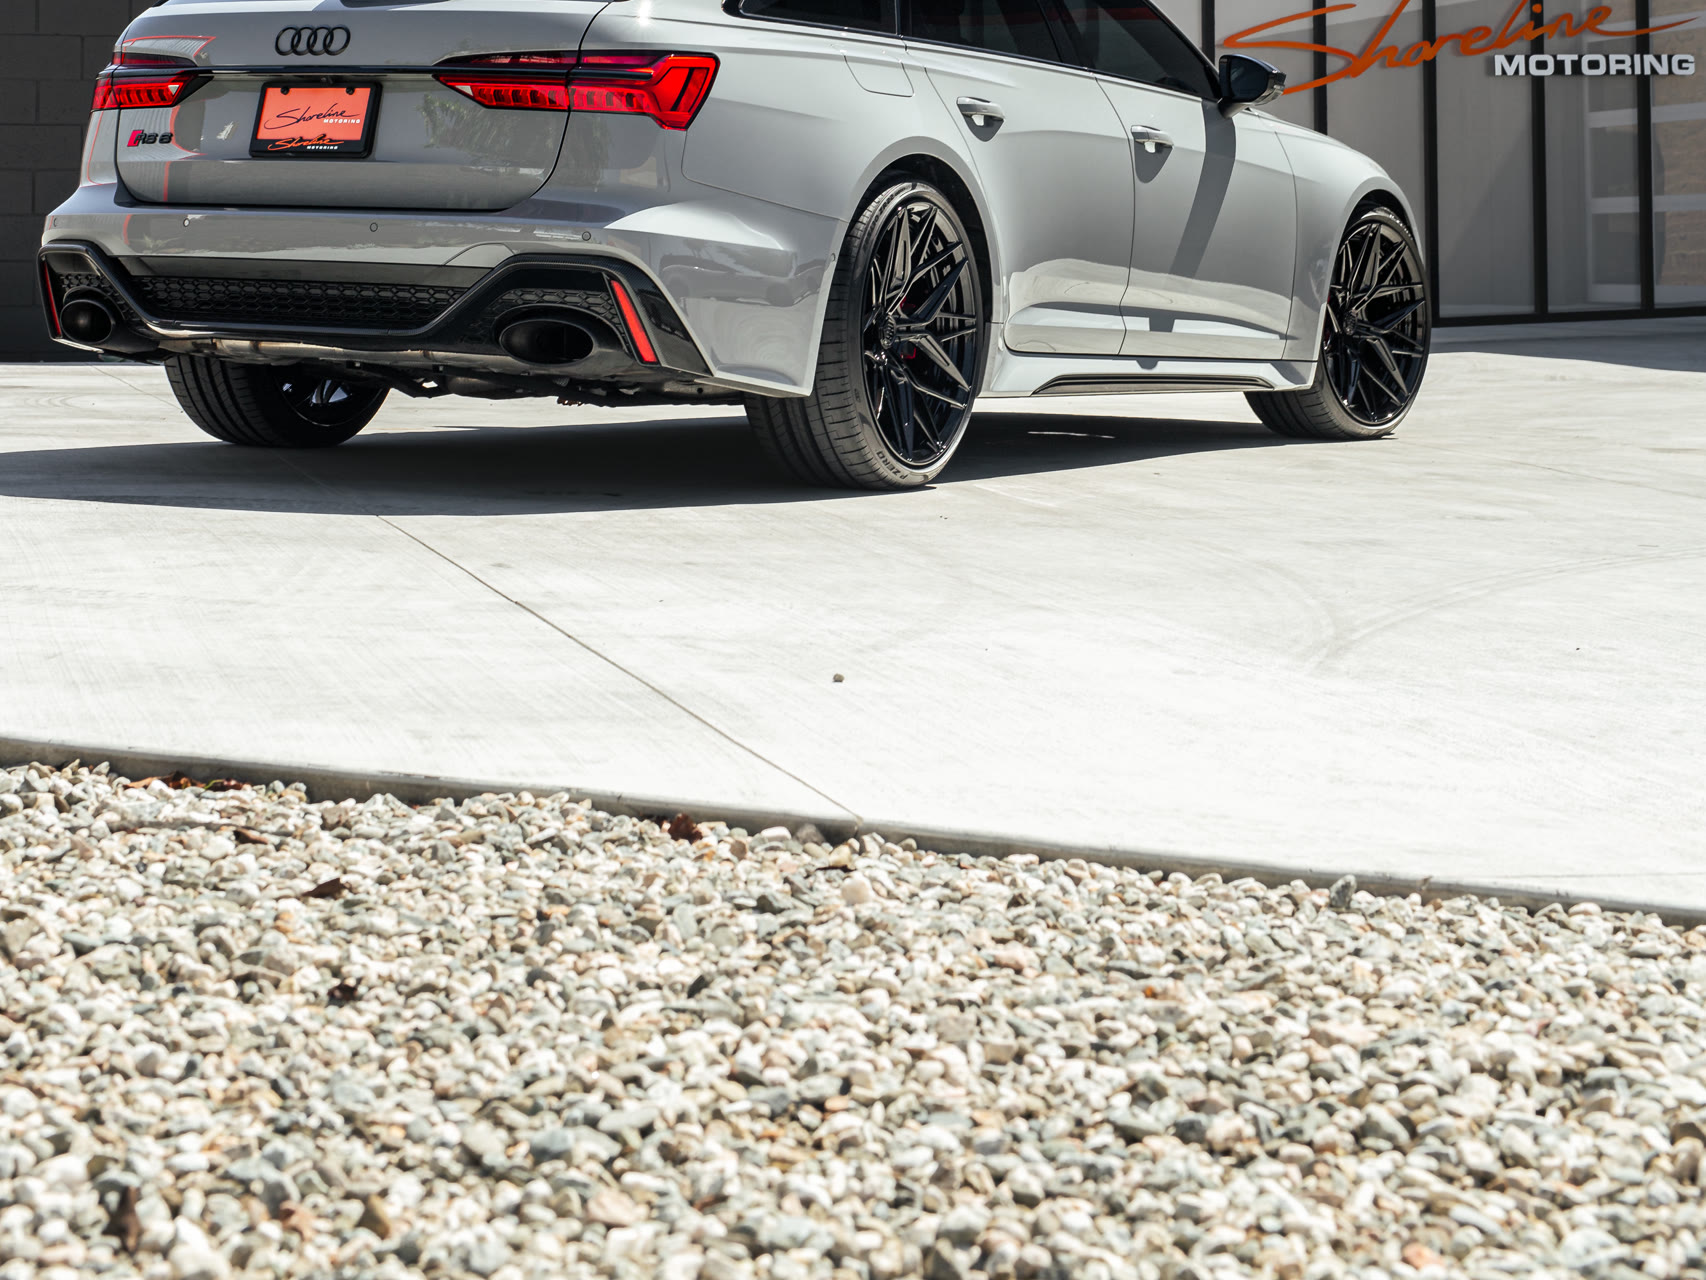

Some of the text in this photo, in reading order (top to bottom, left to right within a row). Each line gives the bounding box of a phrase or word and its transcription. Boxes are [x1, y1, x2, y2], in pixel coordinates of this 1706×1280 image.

[1494, 54, 1696, 76] MOTORING
[264, 102, 360, 130] Shoreline
[267, 133, 344, 151] Shoreline
[876, 451, 901, 476] ZERO
